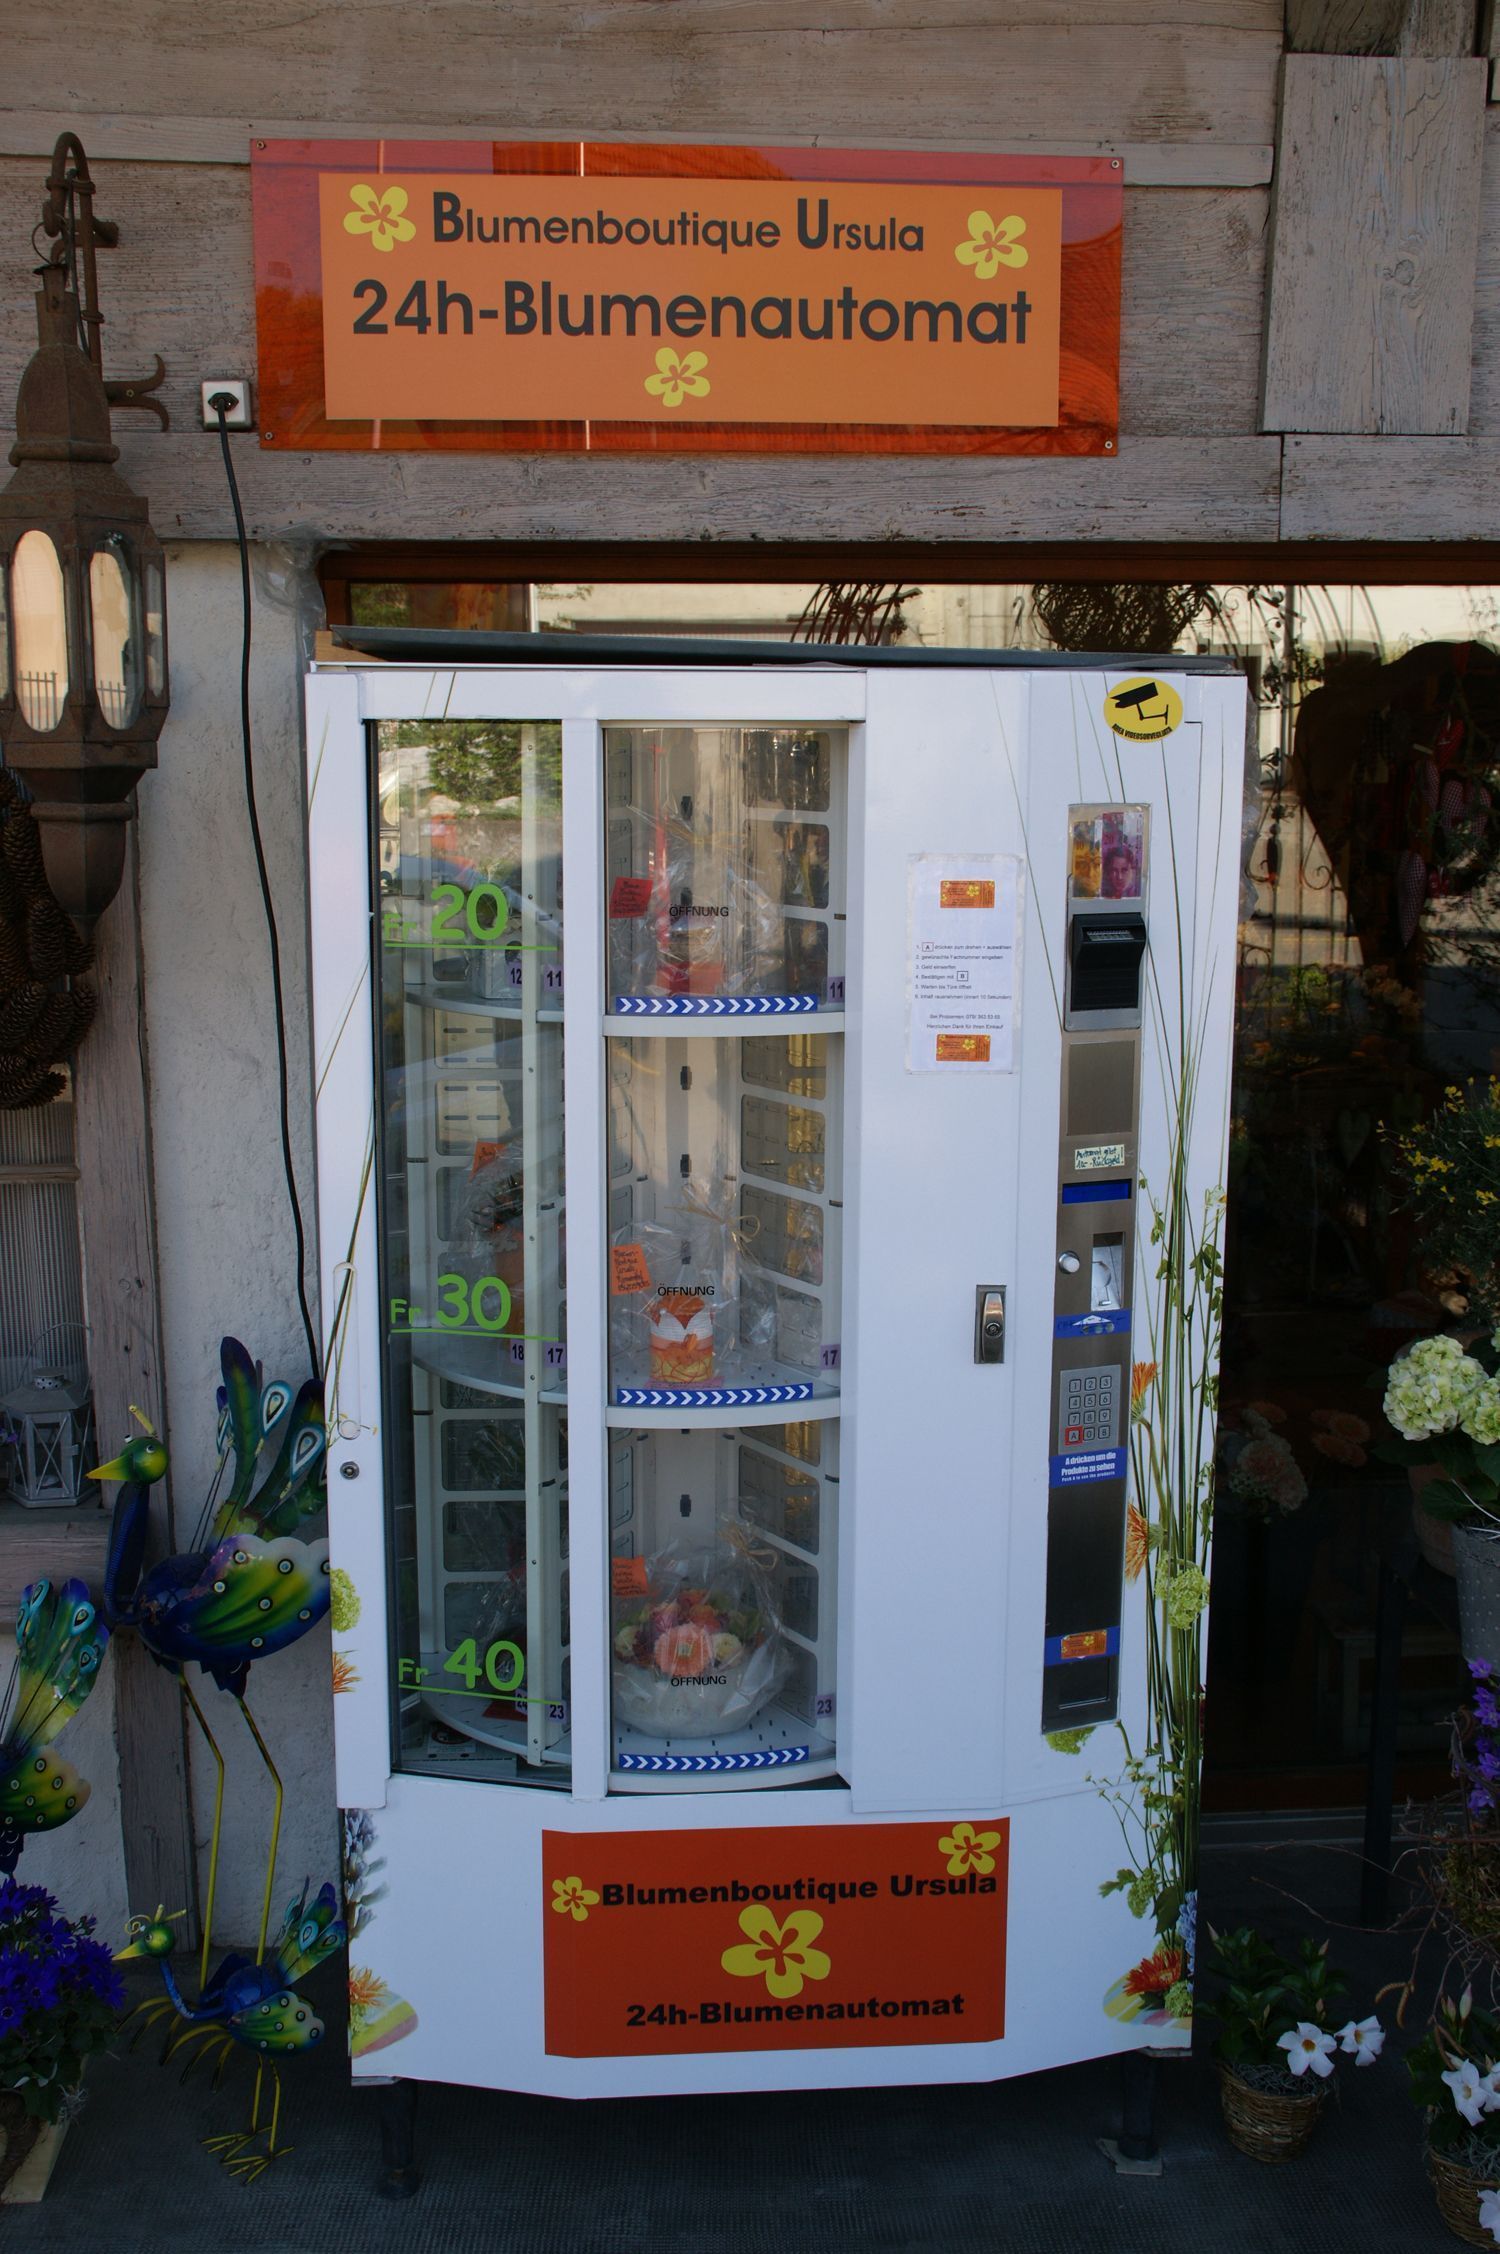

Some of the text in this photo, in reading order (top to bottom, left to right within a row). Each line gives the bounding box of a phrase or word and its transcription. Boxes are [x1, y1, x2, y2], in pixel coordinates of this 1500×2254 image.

[432, 191, 924, 254] Blumenboutique Ursula
[352, 279, 1033, 345] 24h-Blumenautomat
[431, 883, 509, 941] 20
[669, 902, 729, 918] ÖFFNUNG
[510, 967, 523, 985] 12
[546, 969, 562, 988] 11
[829, 982, 844, 999] 11
[657, 1283, 715, 1298] ÖFFNUNG
[391, 1273, 512, 1331] Fr 30
[512, 1343, 524, 1361] 18
[547, 1347, 563, 1364] 17
[822, 1350, 838, 1366] 17
[1070, 1455, 1095, 1464] drücken
[1106, 1451, 1116, 1460] die
[1061, 1466, 1089, 1476] Produkte
[1096, 1462, 1115, 1471] sehen
[399, 1638, 525, 1692] Fr 40
[671, 1673, 727, 1688] ÖFFNUNG
[549, 1703, 565, 1720] 23
[817, 1699, 832, 1715] 23
[602, 1873, 998, 1906] Blumenboutique Ursula
[626, 1993, 965, 2028] 24h-Blumenautomat
